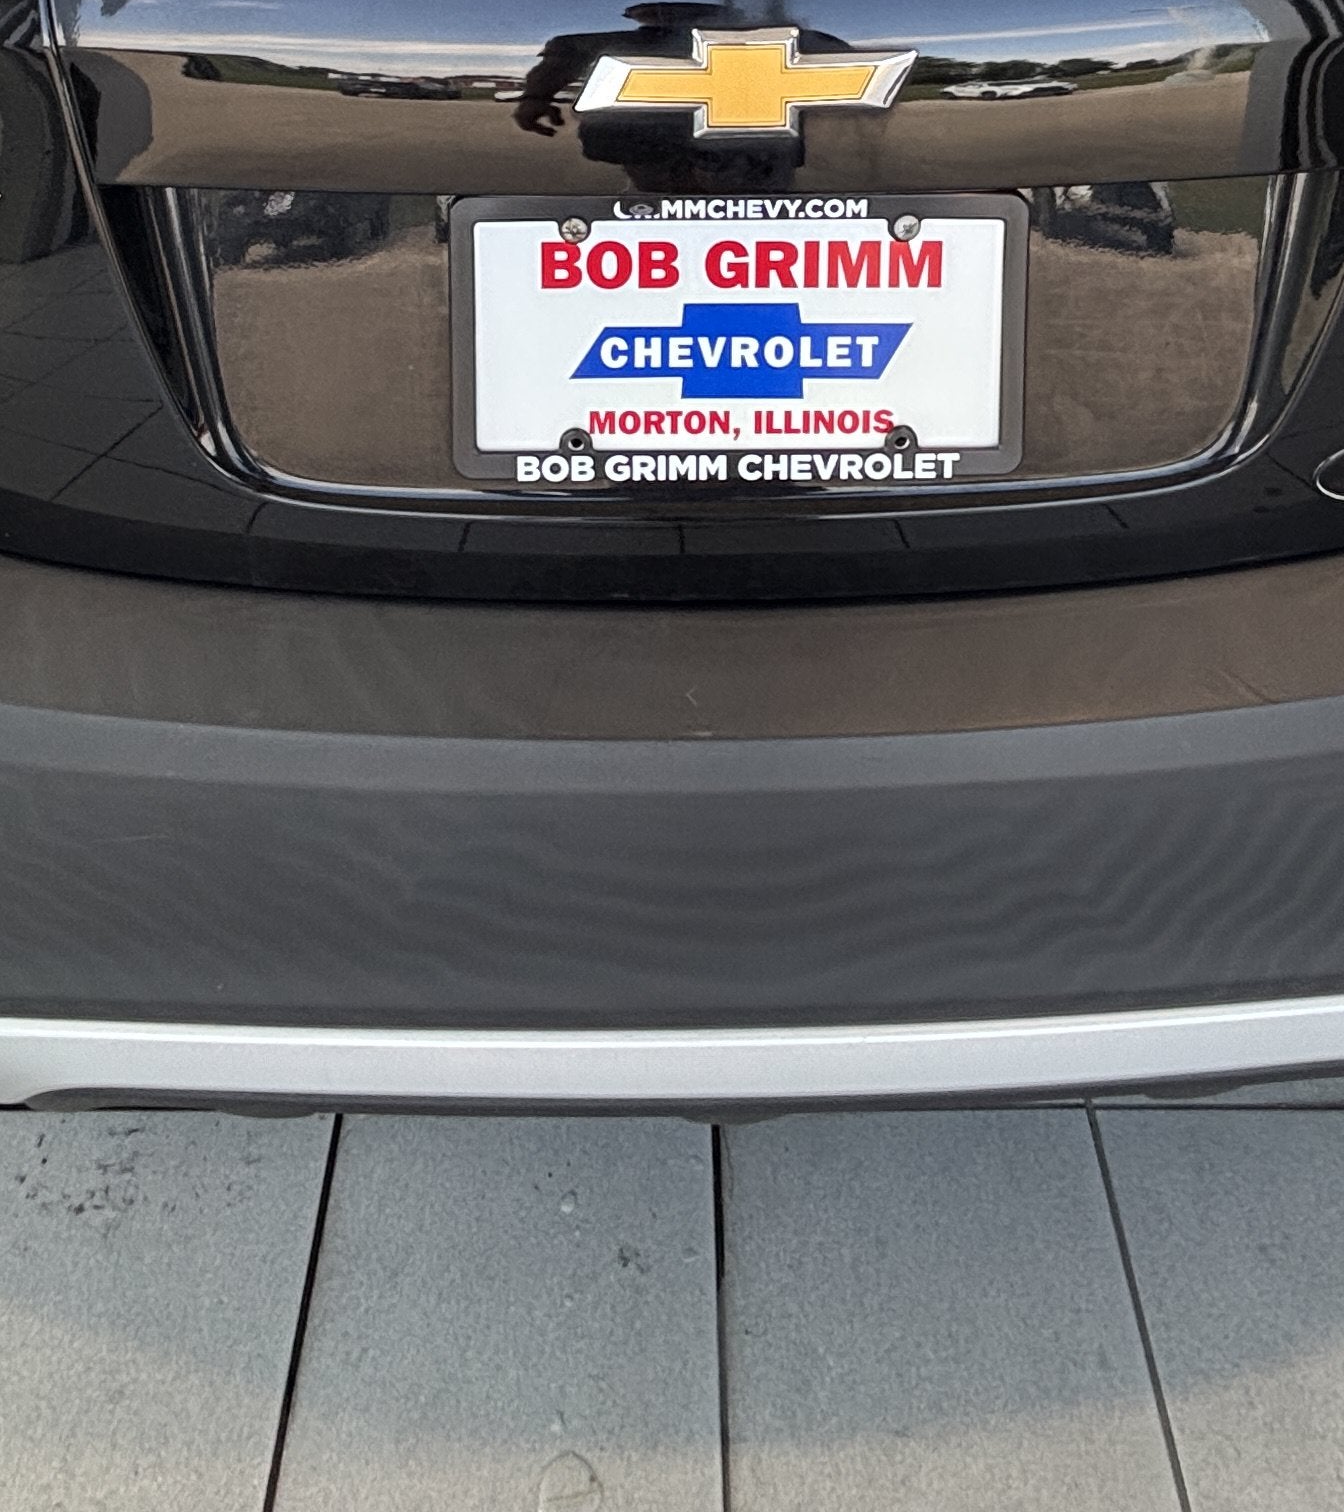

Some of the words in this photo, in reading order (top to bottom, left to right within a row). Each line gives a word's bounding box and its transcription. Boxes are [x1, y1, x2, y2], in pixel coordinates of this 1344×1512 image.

[613, 198, 869, 220] MMCHEVY.COM
[540, 240, 680, 289] BOB
[705, 240, 944, 289] GRIMM
[599, 335, 880, 369] CHEVROLET
[588, 410, 742, 441] MORTON,
[753, 409, 896, 435] ILLINOIS
[516, 455, 596, 484] BOB
[604, 454, 728, 482] GRIMM
[737, 452, 961, 481] CHEVROLET
